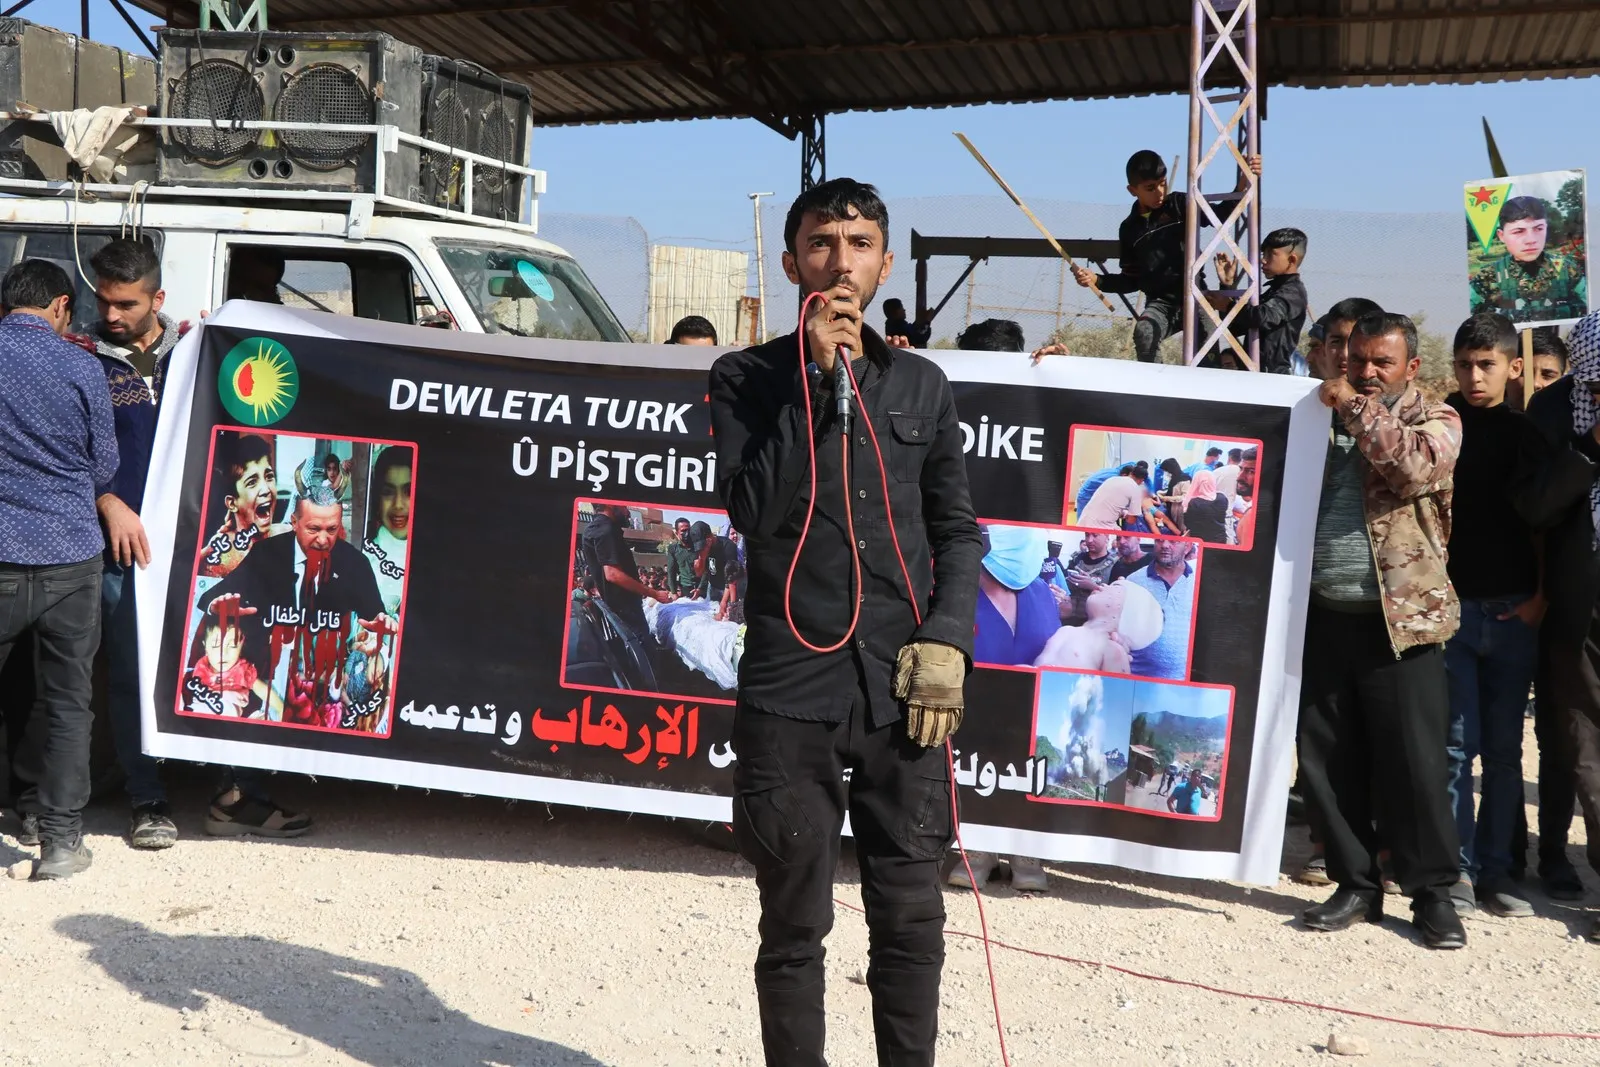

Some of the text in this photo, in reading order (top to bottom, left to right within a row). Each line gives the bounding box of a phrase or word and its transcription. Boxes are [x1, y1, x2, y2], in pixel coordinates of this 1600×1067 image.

[389, 378, 572, 425] DEWLETA
[584, 396, 693, 434] TURK
[512, 436, 539, 476] Û
[206, 525, 258, 564] سري كاني
[262, 604, 341, 633] قاتل اطفال
[186, 678, 223, 713] عفرين
[341, 690, 383, 728] كوباني
[531, 695, 699, 771] الإرهاب
